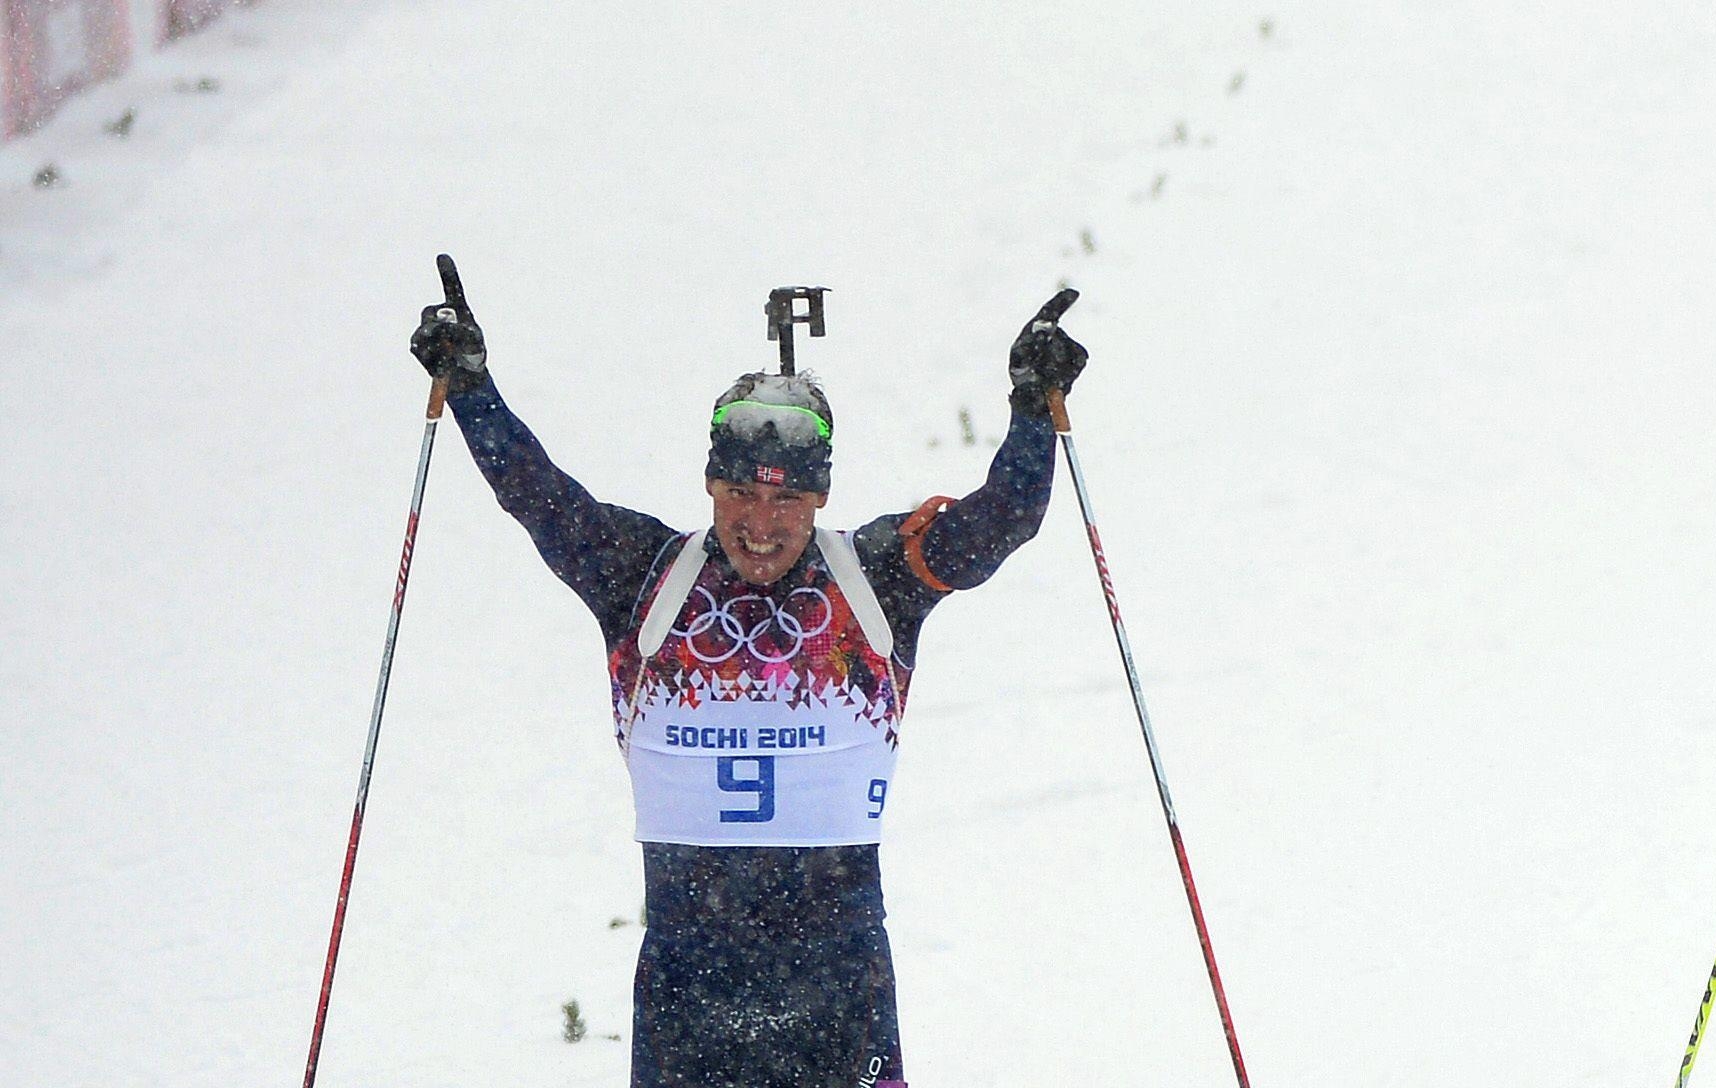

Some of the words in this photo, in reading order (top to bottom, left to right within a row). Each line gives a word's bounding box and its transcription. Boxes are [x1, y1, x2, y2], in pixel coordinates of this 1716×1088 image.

[665, 724, 748, 749] SOCHI
[757, 724, 826, 748] 2014
[716, 755, 776, 823] 9
[867, 778, 888, 819] 9
